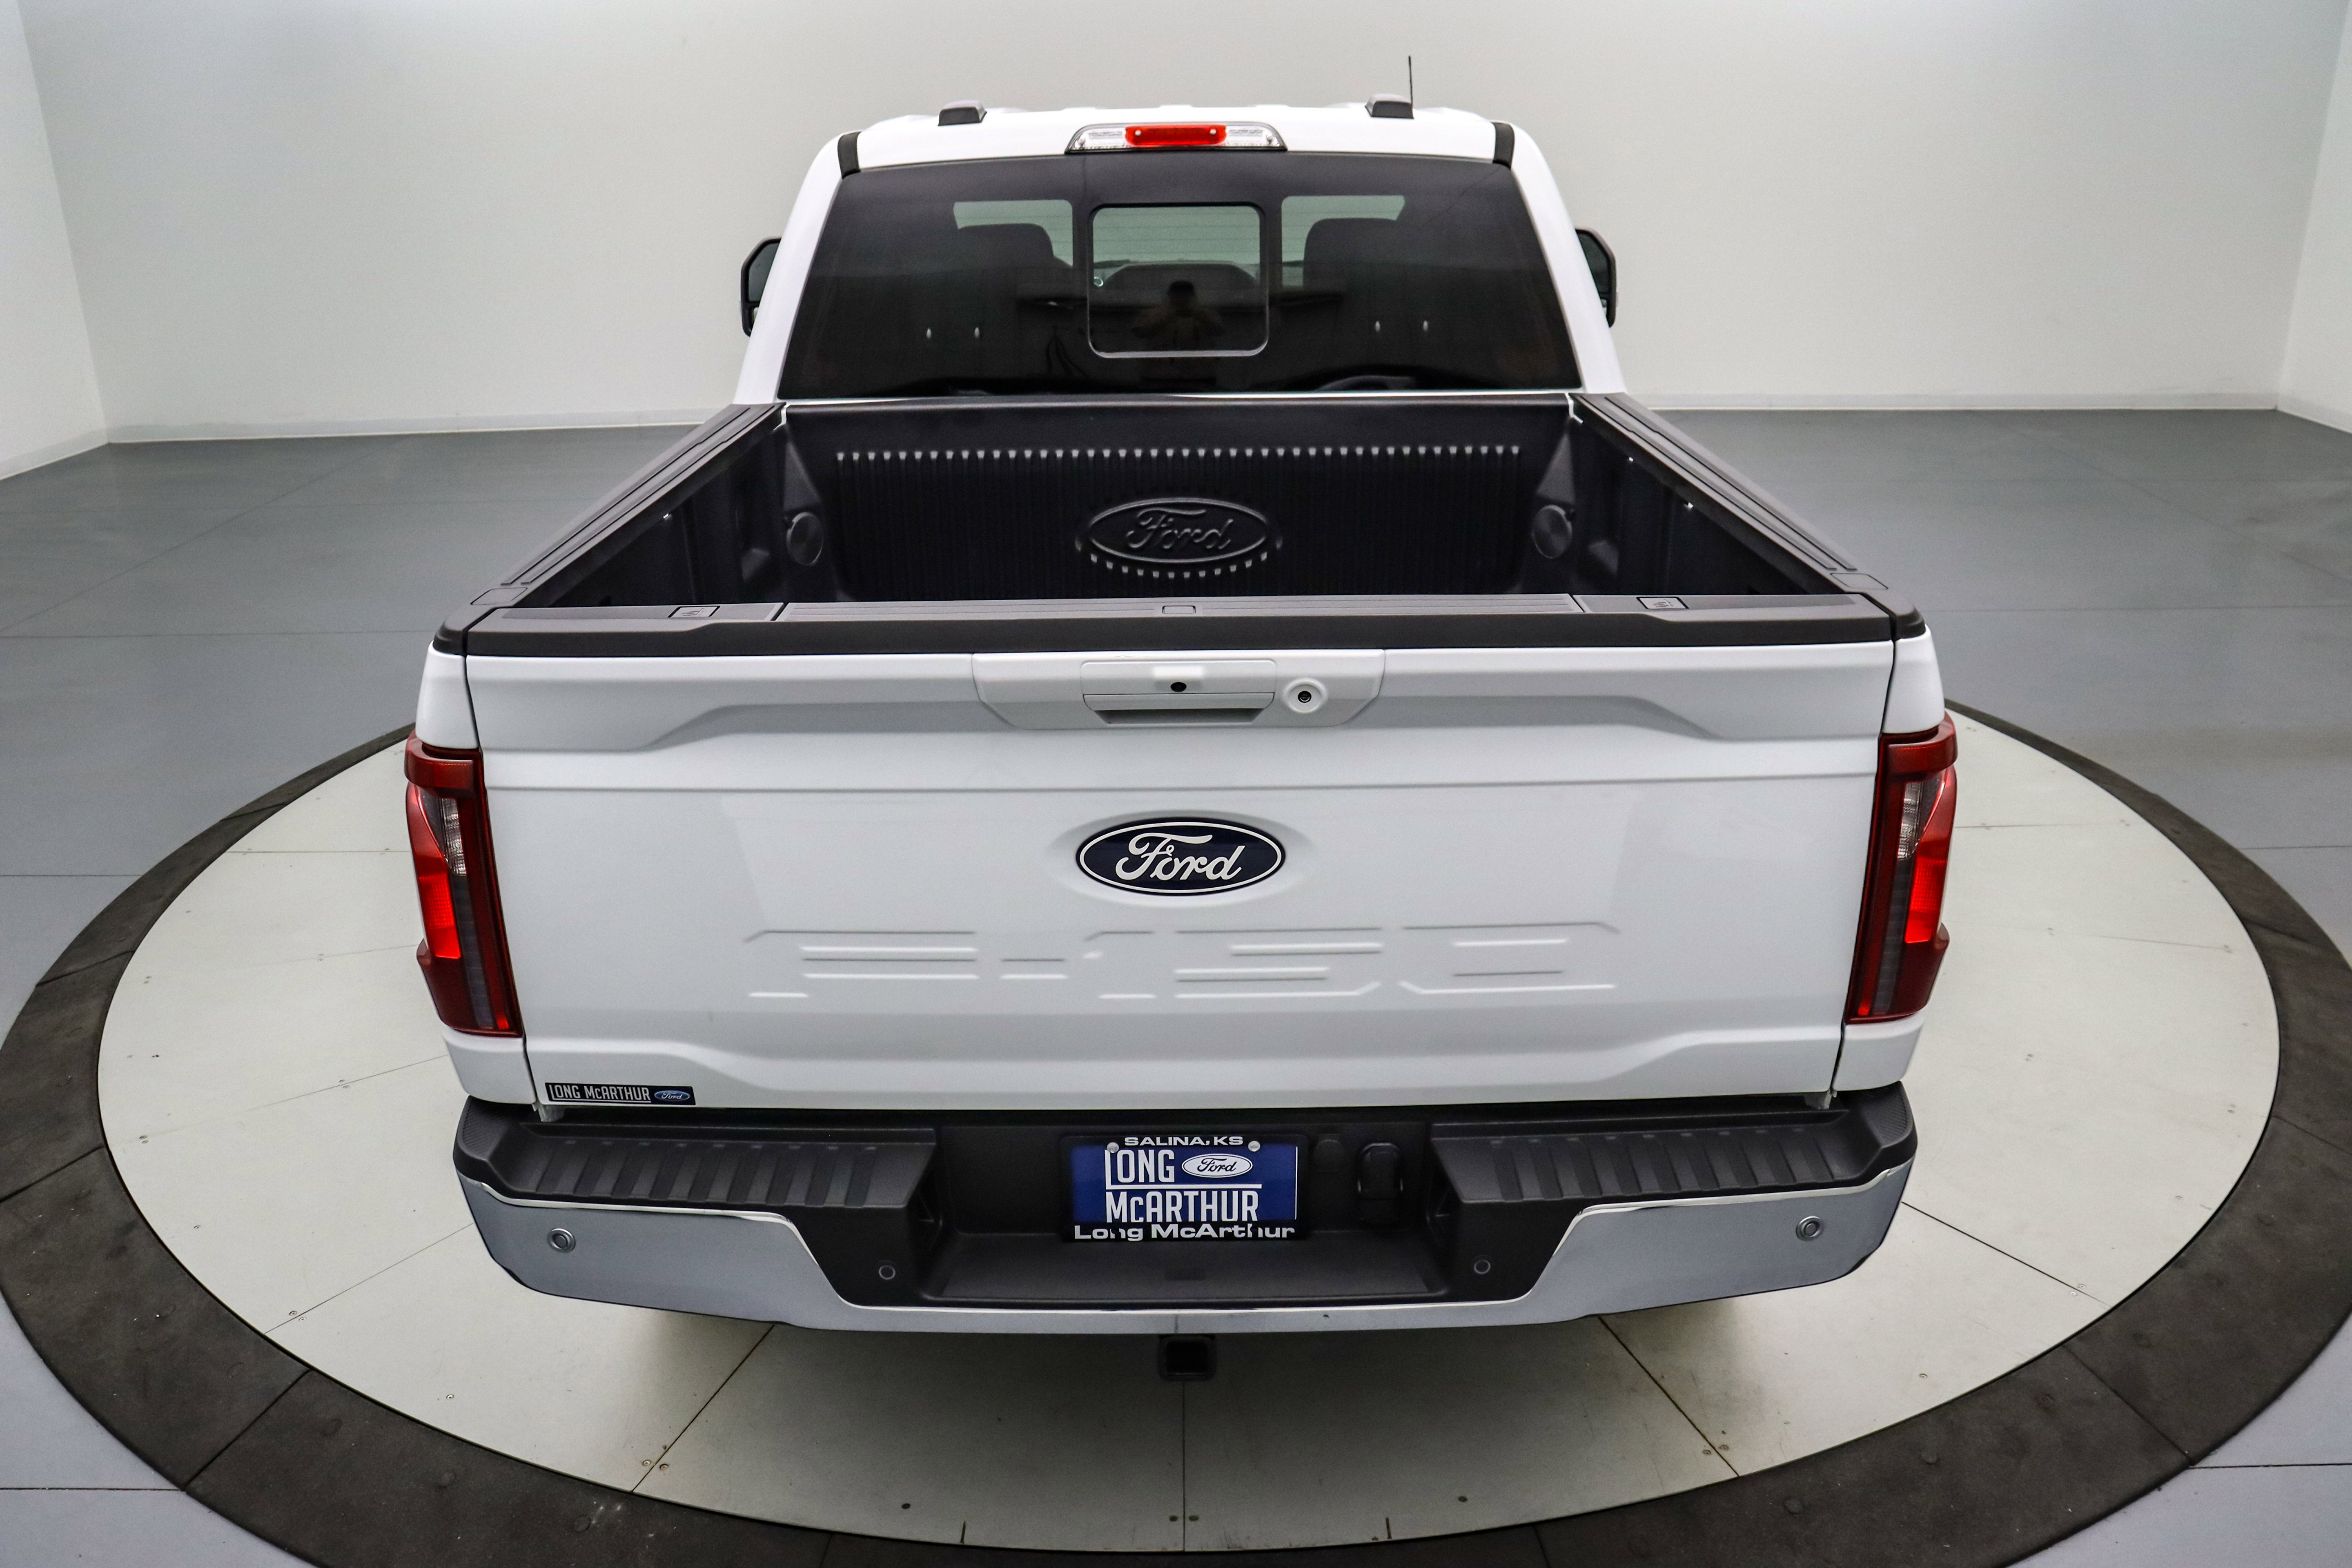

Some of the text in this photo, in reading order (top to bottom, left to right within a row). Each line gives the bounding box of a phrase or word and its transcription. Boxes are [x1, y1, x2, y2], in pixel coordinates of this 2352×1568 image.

[1125, 507, 1234, 549] Ford
[1115, 832, 1245, 880] Ford
[549, 1084, 581, 1100] LONG
[584, 1085, 651, 1100] McARTHUR
[1124, 1136, 1243, 1146] SALINA, KS
[1105, 1149, 1237, 1190] LONG Ford
[1106, 1190, 1258, 1223] McARTHUR
[1074, 1223, 1295, 1241] Long McArthur
